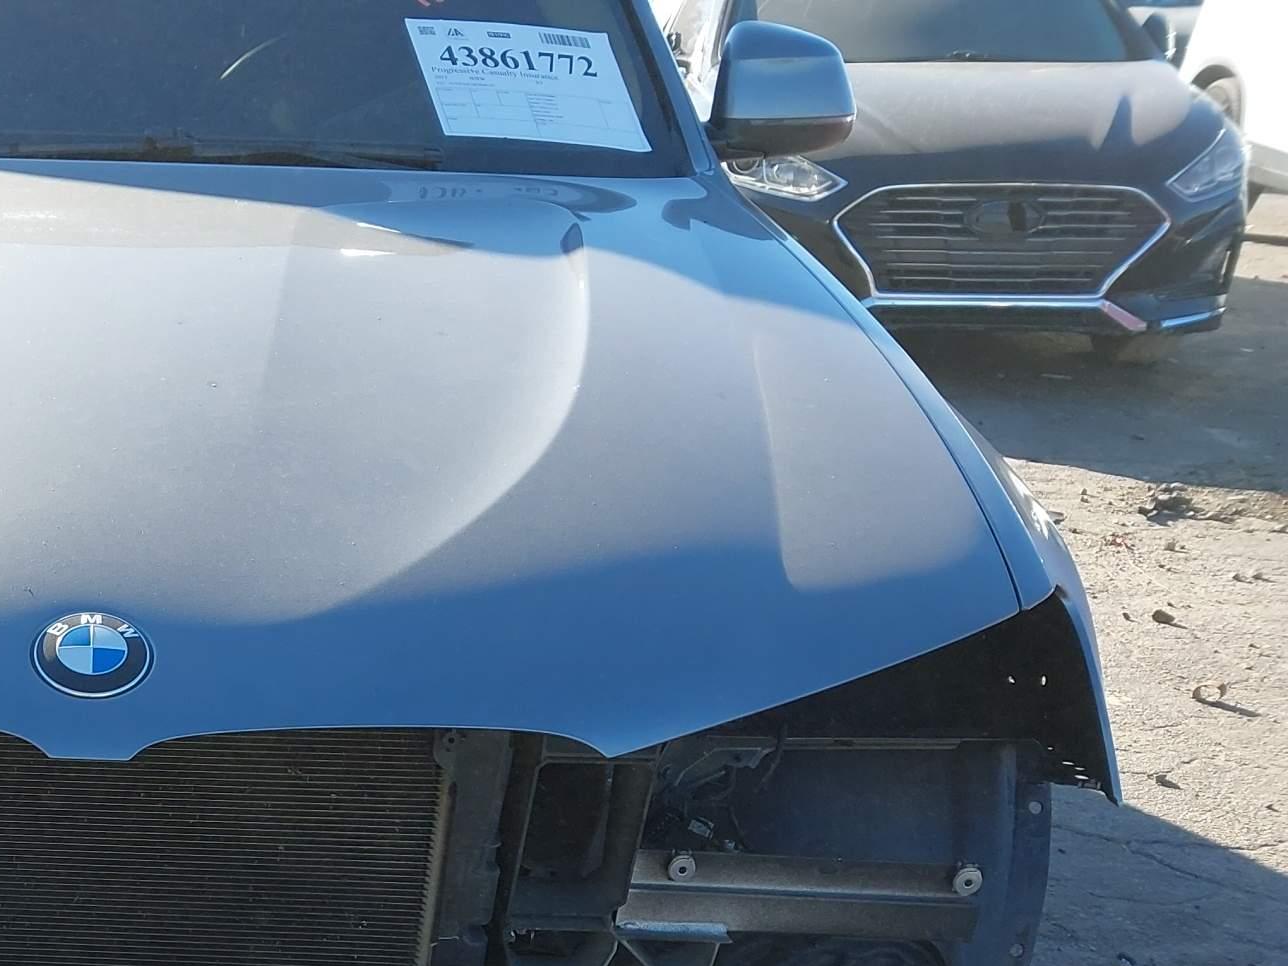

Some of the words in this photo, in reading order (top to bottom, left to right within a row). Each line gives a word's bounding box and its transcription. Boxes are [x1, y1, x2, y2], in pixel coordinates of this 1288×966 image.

[431, 66, 479, 75] Progressive
[481, 69, 517, 78] Casualty
[439, 44, 599, 78] 43861772
[47, 614, 140, 639] BMW
